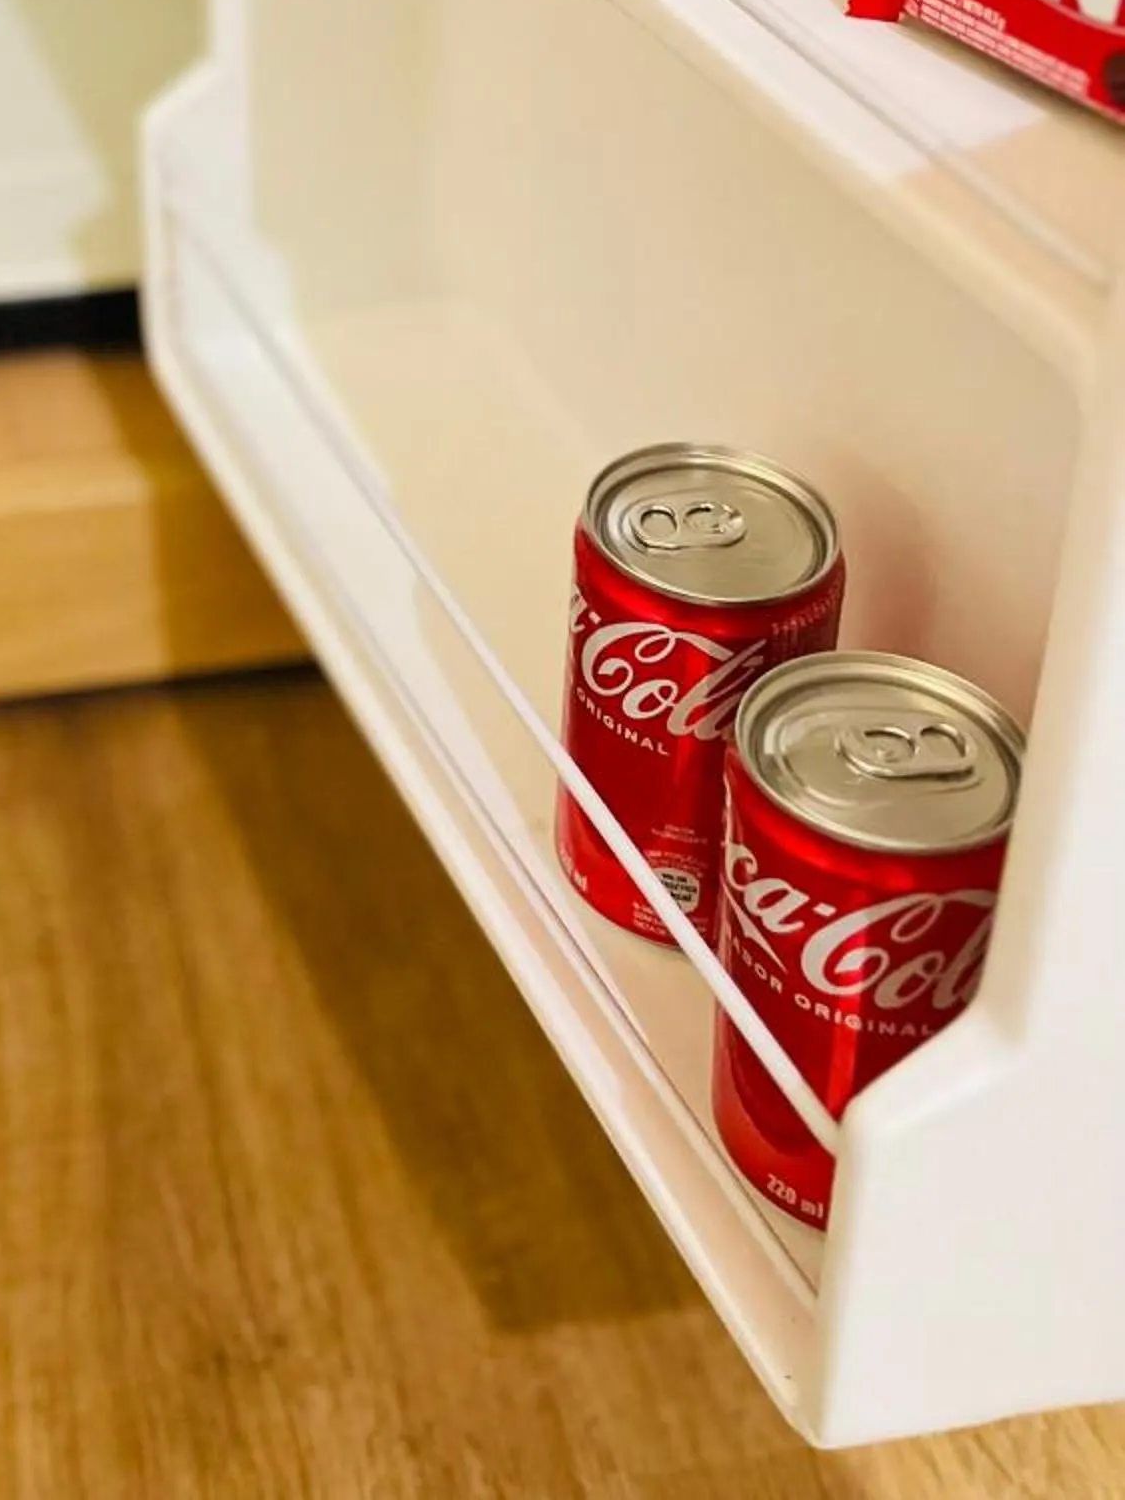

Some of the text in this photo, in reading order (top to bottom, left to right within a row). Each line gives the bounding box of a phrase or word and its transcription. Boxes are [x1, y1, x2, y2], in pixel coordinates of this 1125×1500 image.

[576, 686, 670, 757] ORIGINAL
[794, 993, 933, 1037] ORIGINAL
[766, 1172, 824, 1219] 220 ml
